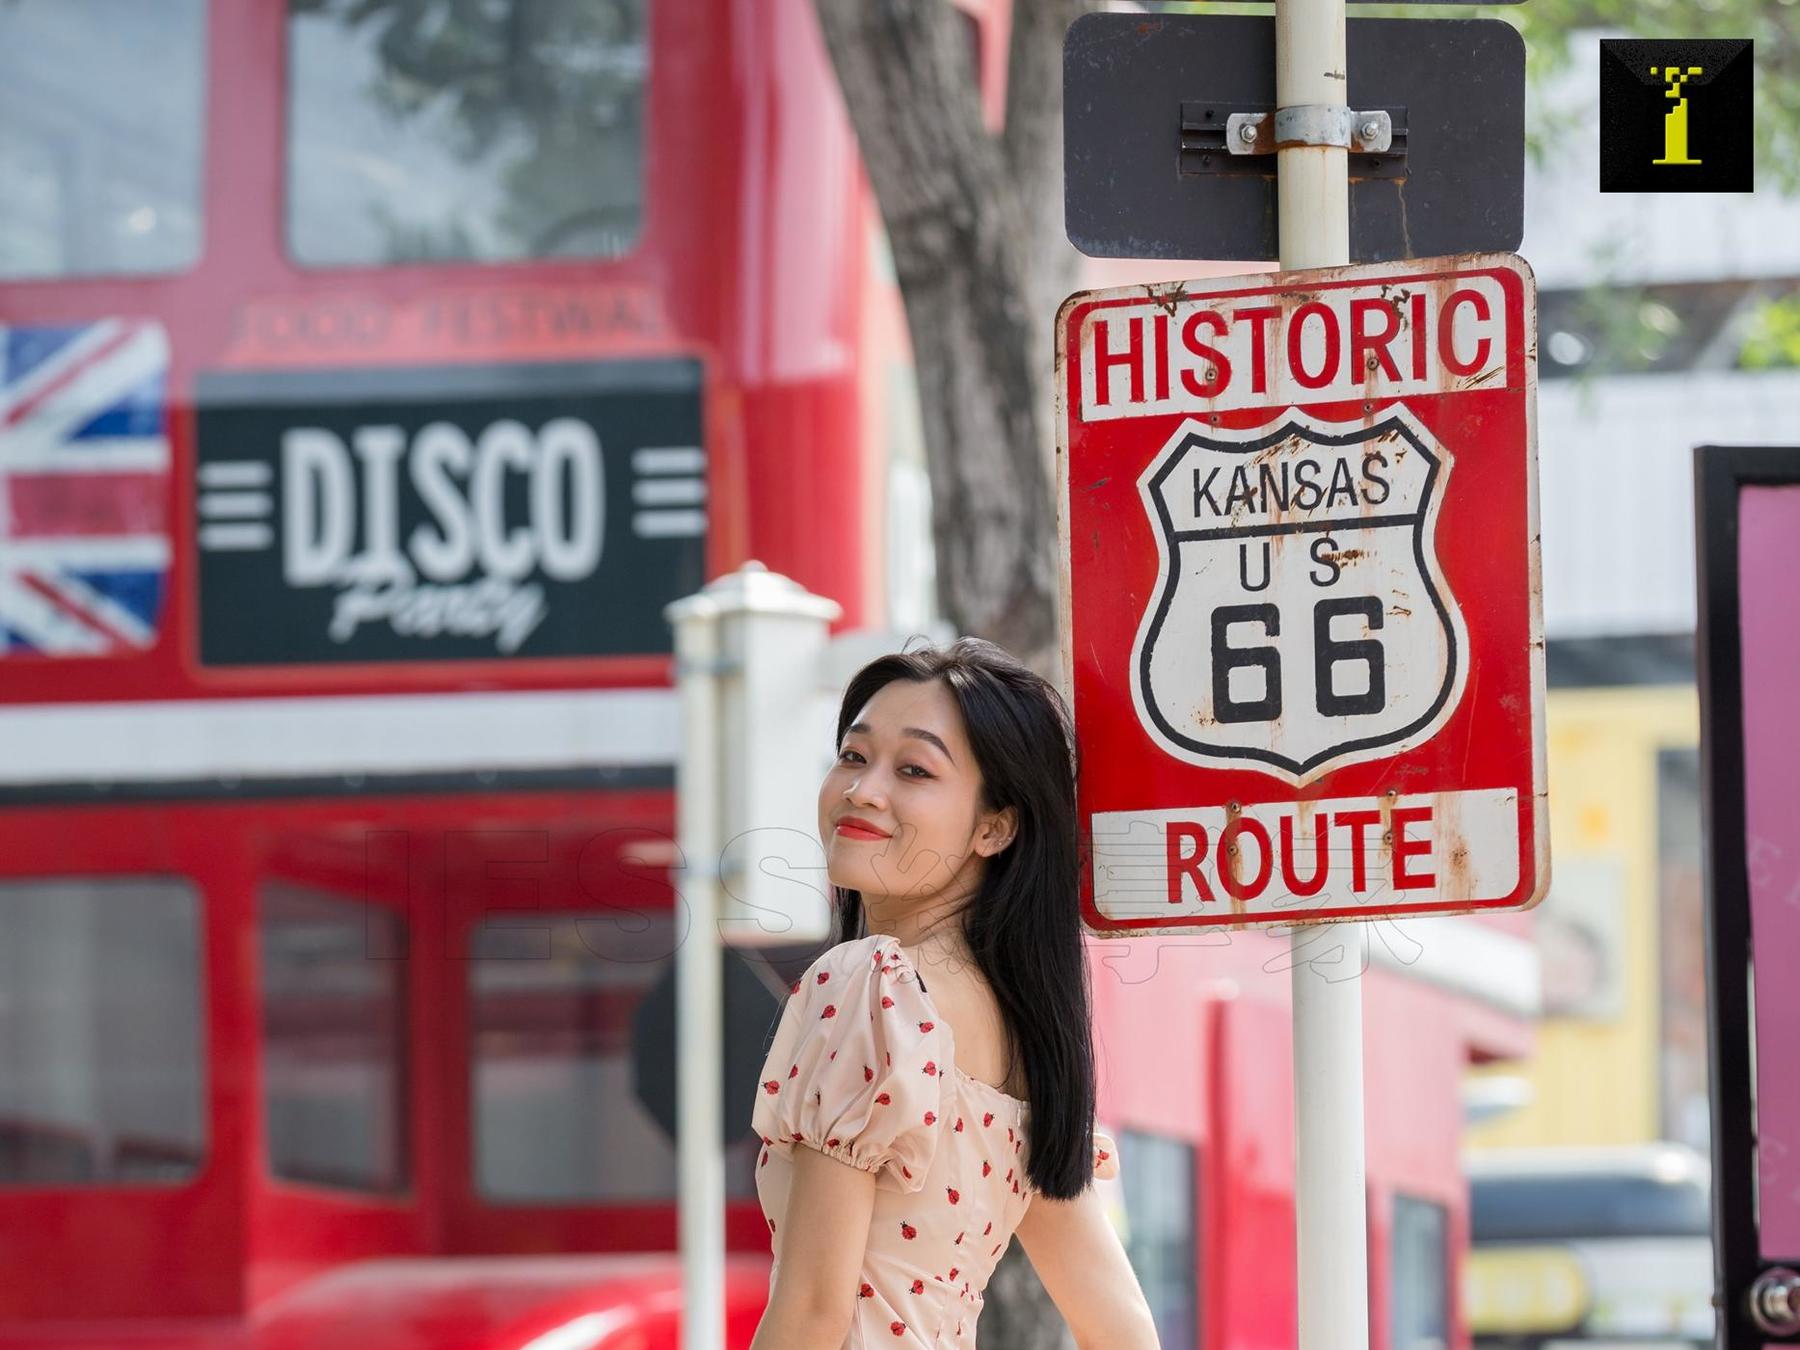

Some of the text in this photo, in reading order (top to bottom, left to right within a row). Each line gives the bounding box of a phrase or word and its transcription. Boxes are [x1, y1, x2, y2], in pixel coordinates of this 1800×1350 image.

[1094, 288, 1493, 406] HISTORIC
[280, 417, 607, 588] DISCO
[1193, 451, 1391, 518] KANSAS
[1210, 595, 1386, 724] 66
[1164, 806, 1436, 904] ROUTE
